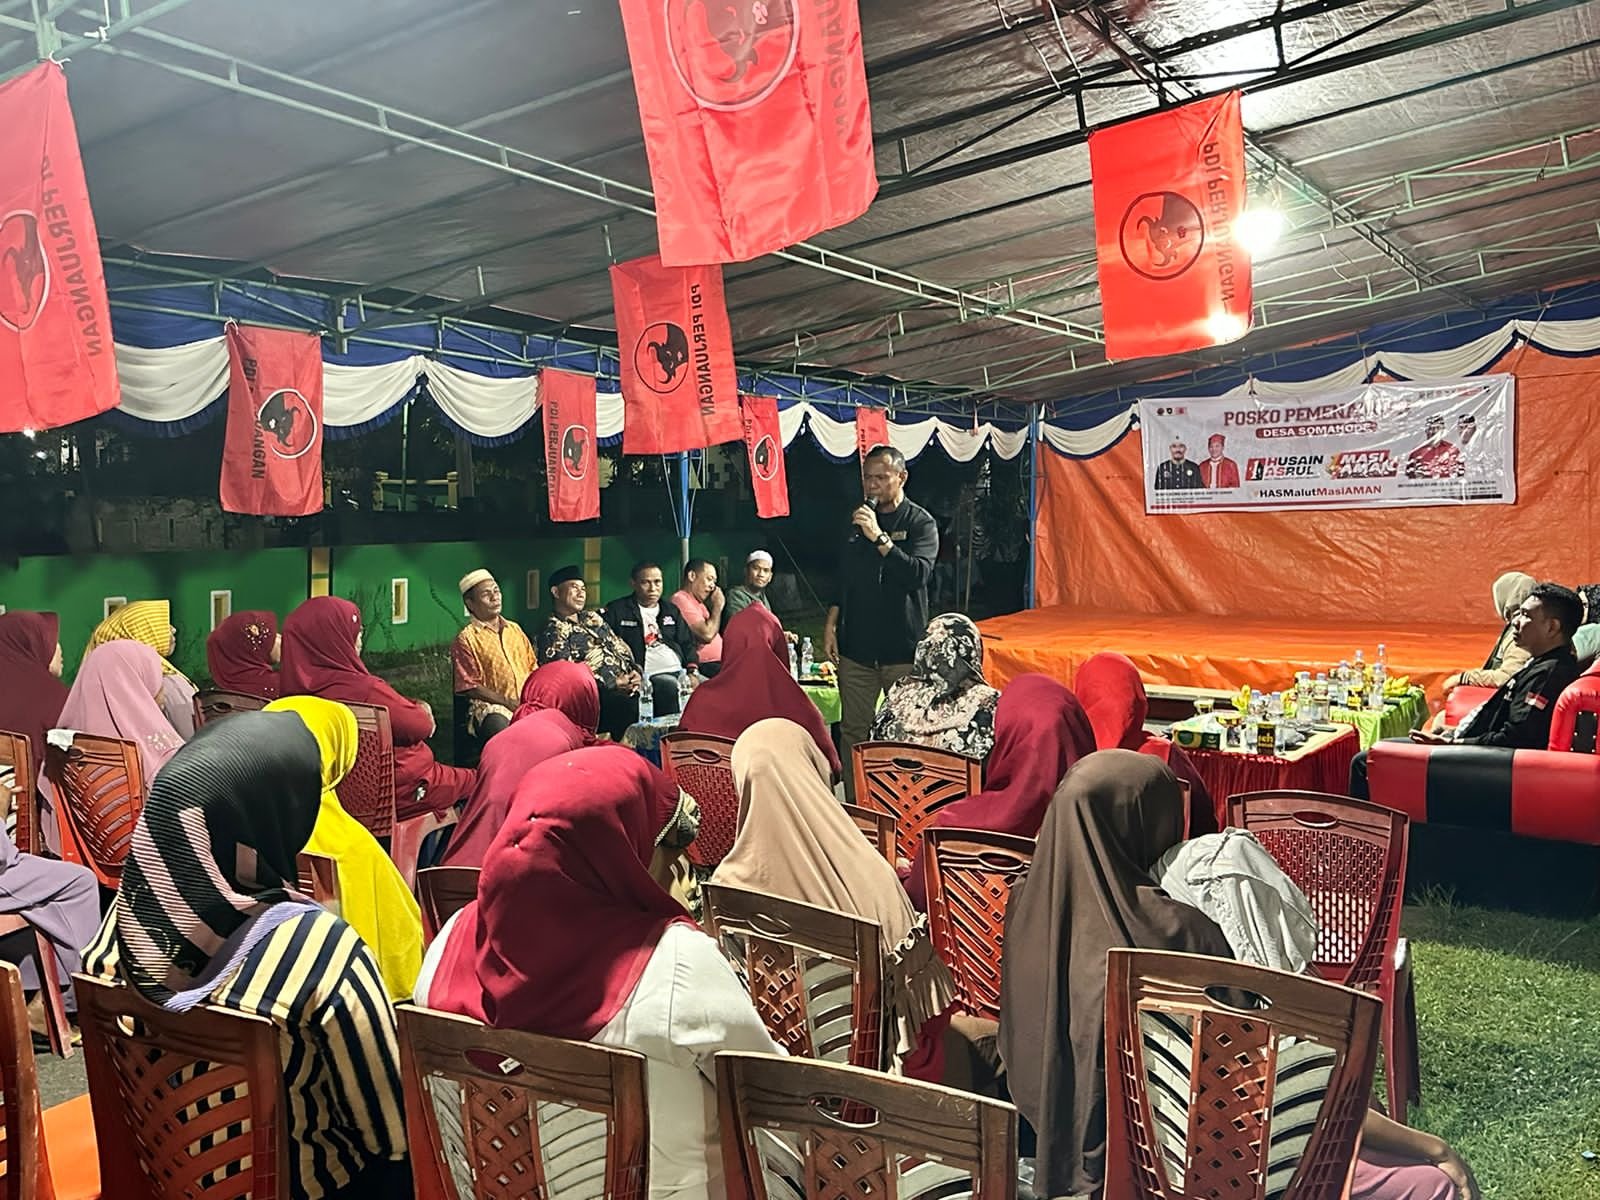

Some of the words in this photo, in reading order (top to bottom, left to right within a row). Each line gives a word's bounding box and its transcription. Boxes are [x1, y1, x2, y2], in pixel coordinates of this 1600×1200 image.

[1223, 408, 1280, 427] POSKO
[1284, 401, 1408, 424] PEMENA
[1263, 428, 1296, 438] DESA
[1266, 455, 1324, 467] HUSAIN
[1340, 451, 1386, 465] MASI
[1265, 466, 1315, 477] ASRUL
